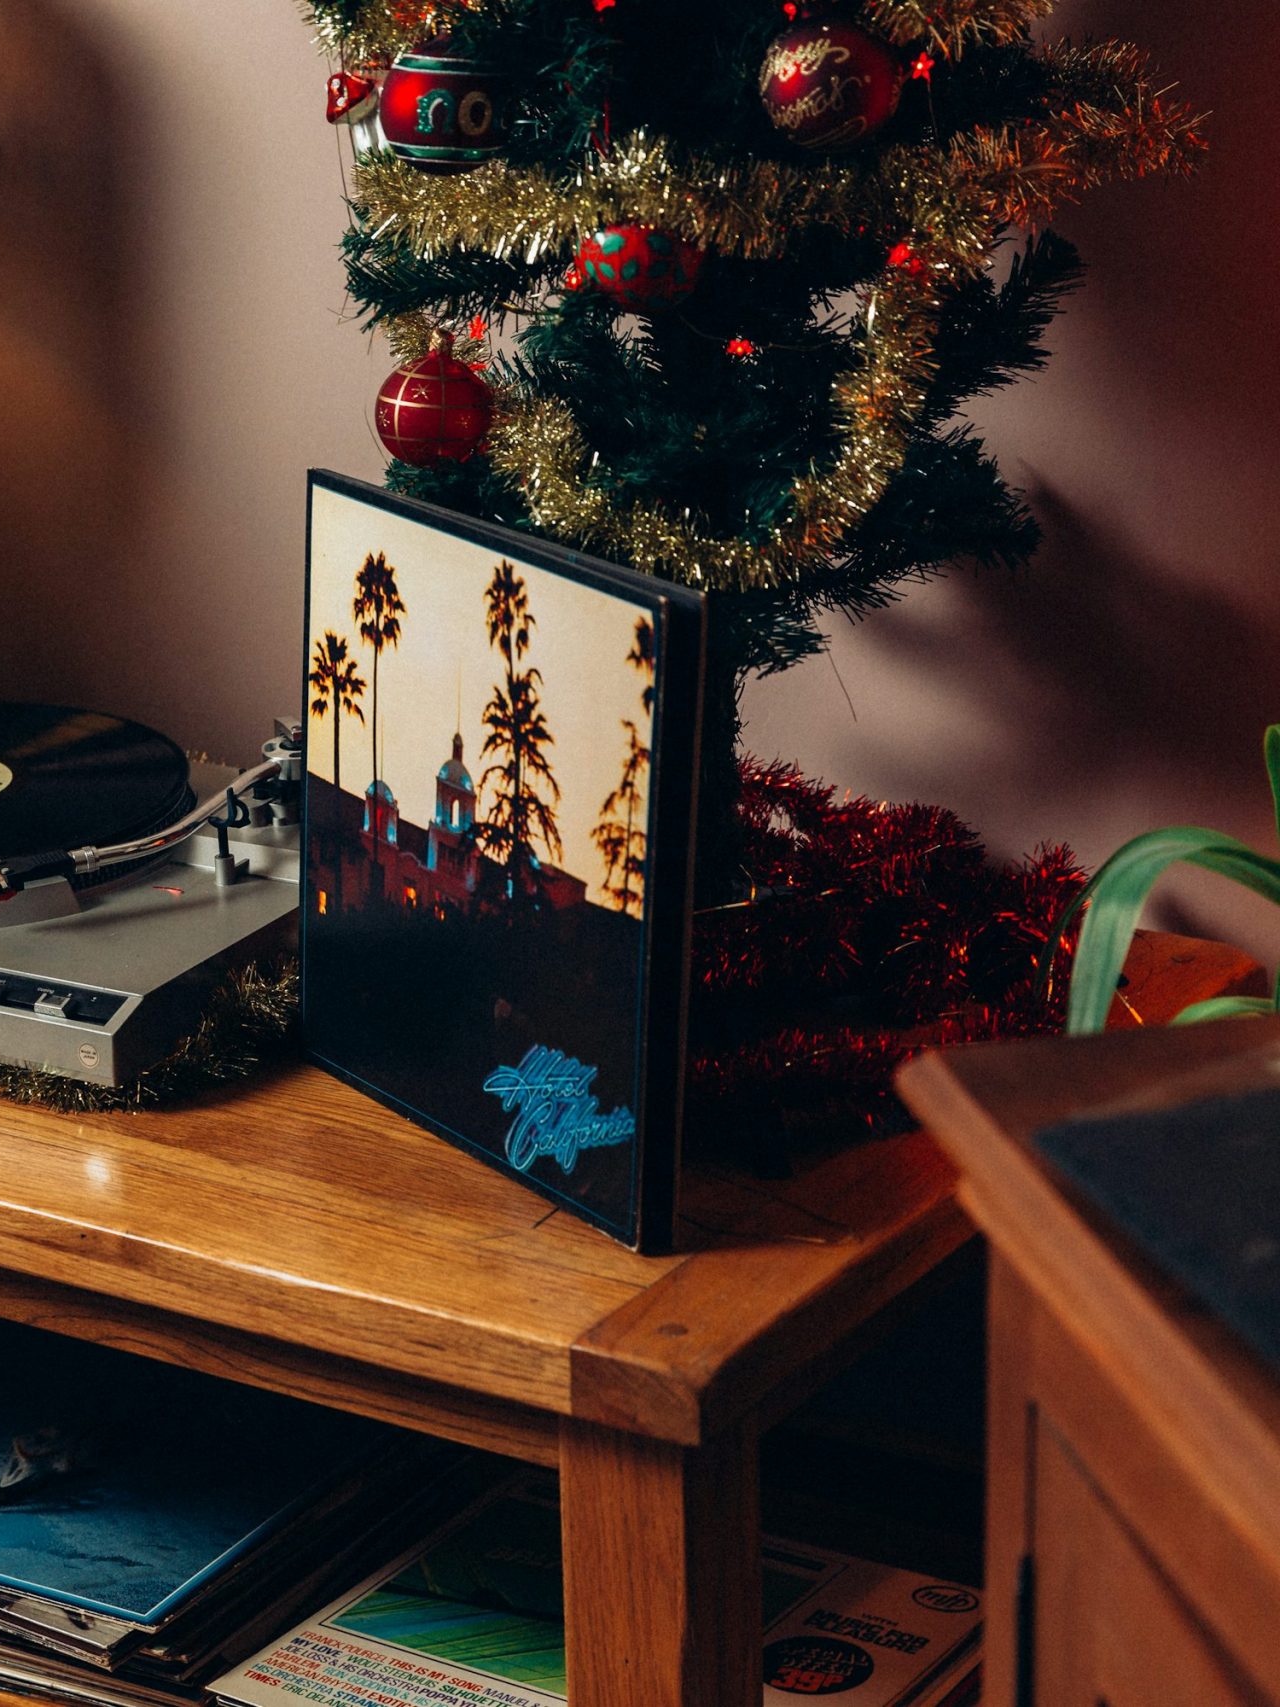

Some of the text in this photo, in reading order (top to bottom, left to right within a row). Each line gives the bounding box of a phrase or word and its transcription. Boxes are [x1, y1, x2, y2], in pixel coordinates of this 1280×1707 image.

[416, 89, 506, 135] no
[483, 1044, 597, 1111] Hotel
[506, 1101, 636, 1174] California
[919, 1589, 969, 1608] mfp
[803, 1619, 921, 1654] PLEASURE
[812, 1609, 930, 1649] MUSIC FOR
[250, 1663, 273, 1674] HIS
[270, 1668, 334, 1696] ORCHESTRA
[262, 1658, 417, 1707] AMERICAN RHYTHM EXOTIC
[271, 1650, 320, 1670] HARLEM
[322, 1666, 346, 1678] RON
[348, 1676, 400, 1696] GOODWIN
[400, 1692, 410, 1700] &
[411, 1696, 432, 1706] HIS
[280, 1644, 302, 1654] JOE
[301, 1650, 330, 1664] LOSS
[338, 1662, 358, 1673] HIS
[356, 1668, 420, 1694] ORCHESTRA
[418, 1688, 459, 1706] POPPA
[290, 1637, 312, 1648] MY
[312, 1644, 343, 1657] LOVE
[347, 1655, 381, 1670] WOUT
[380, 1665, 440, 1688] STEENHUIS
[300, 1630, 344, 1648] FRANCK
[342, 1644, 387, 1662] POURCEL
[388, 1658, 416, 1671] THIS
[414, 1666, 429, 1675] IS
[428, 1671, 450, 1682] MY
[448, 1678, 483, 1692] SONG
[482, 1688, 530, 1707] MANUEL
[244, 1670, 356, 1707] TIMES ERIC DELANE
